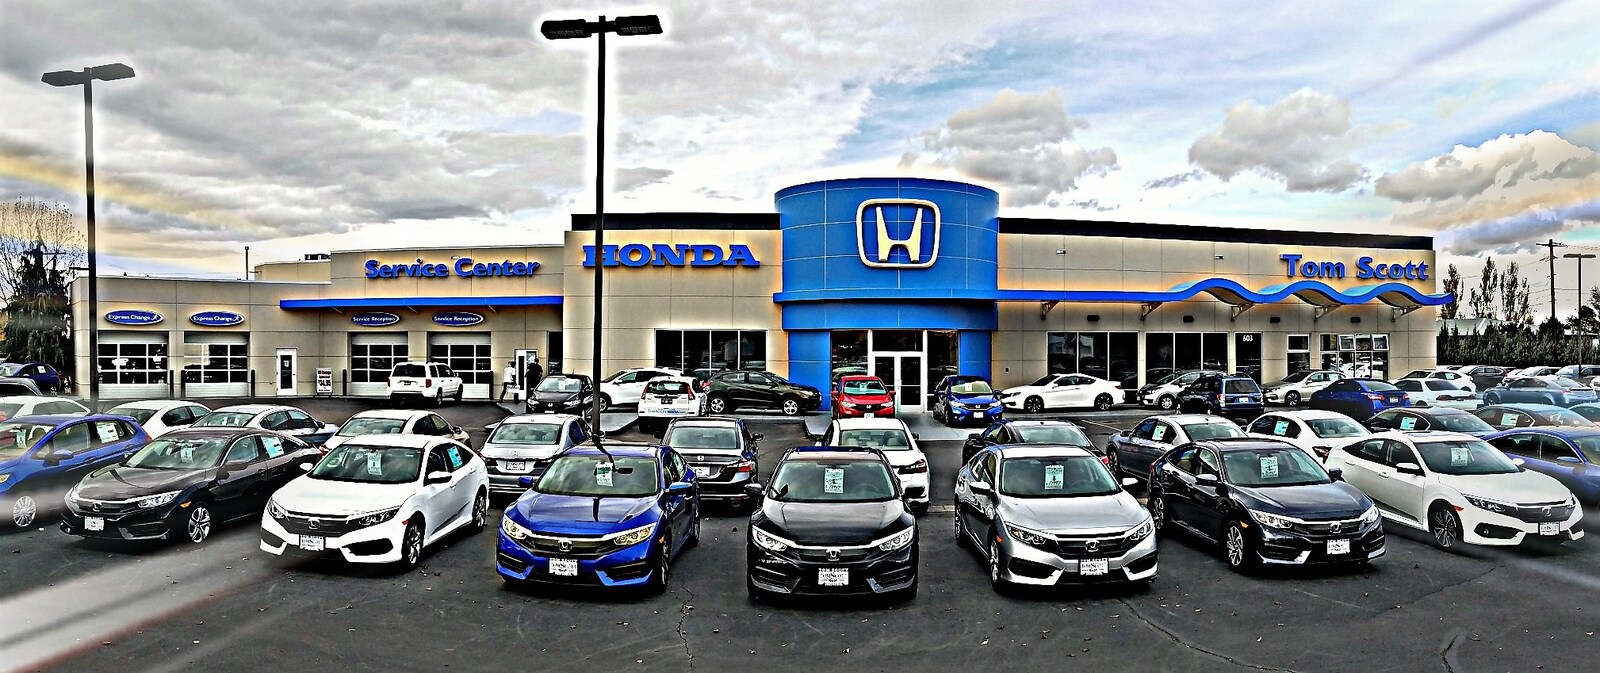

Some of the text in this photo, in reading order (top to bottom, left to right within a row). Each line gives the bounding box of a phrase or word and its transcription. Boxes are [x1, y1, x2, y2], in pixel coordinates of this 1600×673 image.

[582, 243, 760, 268] HONDA
[1280, 254, 1429, 280] Tom Scott
[364, 257, 541, 278] Service Center
[1242, 334, 1254, 342] 603
